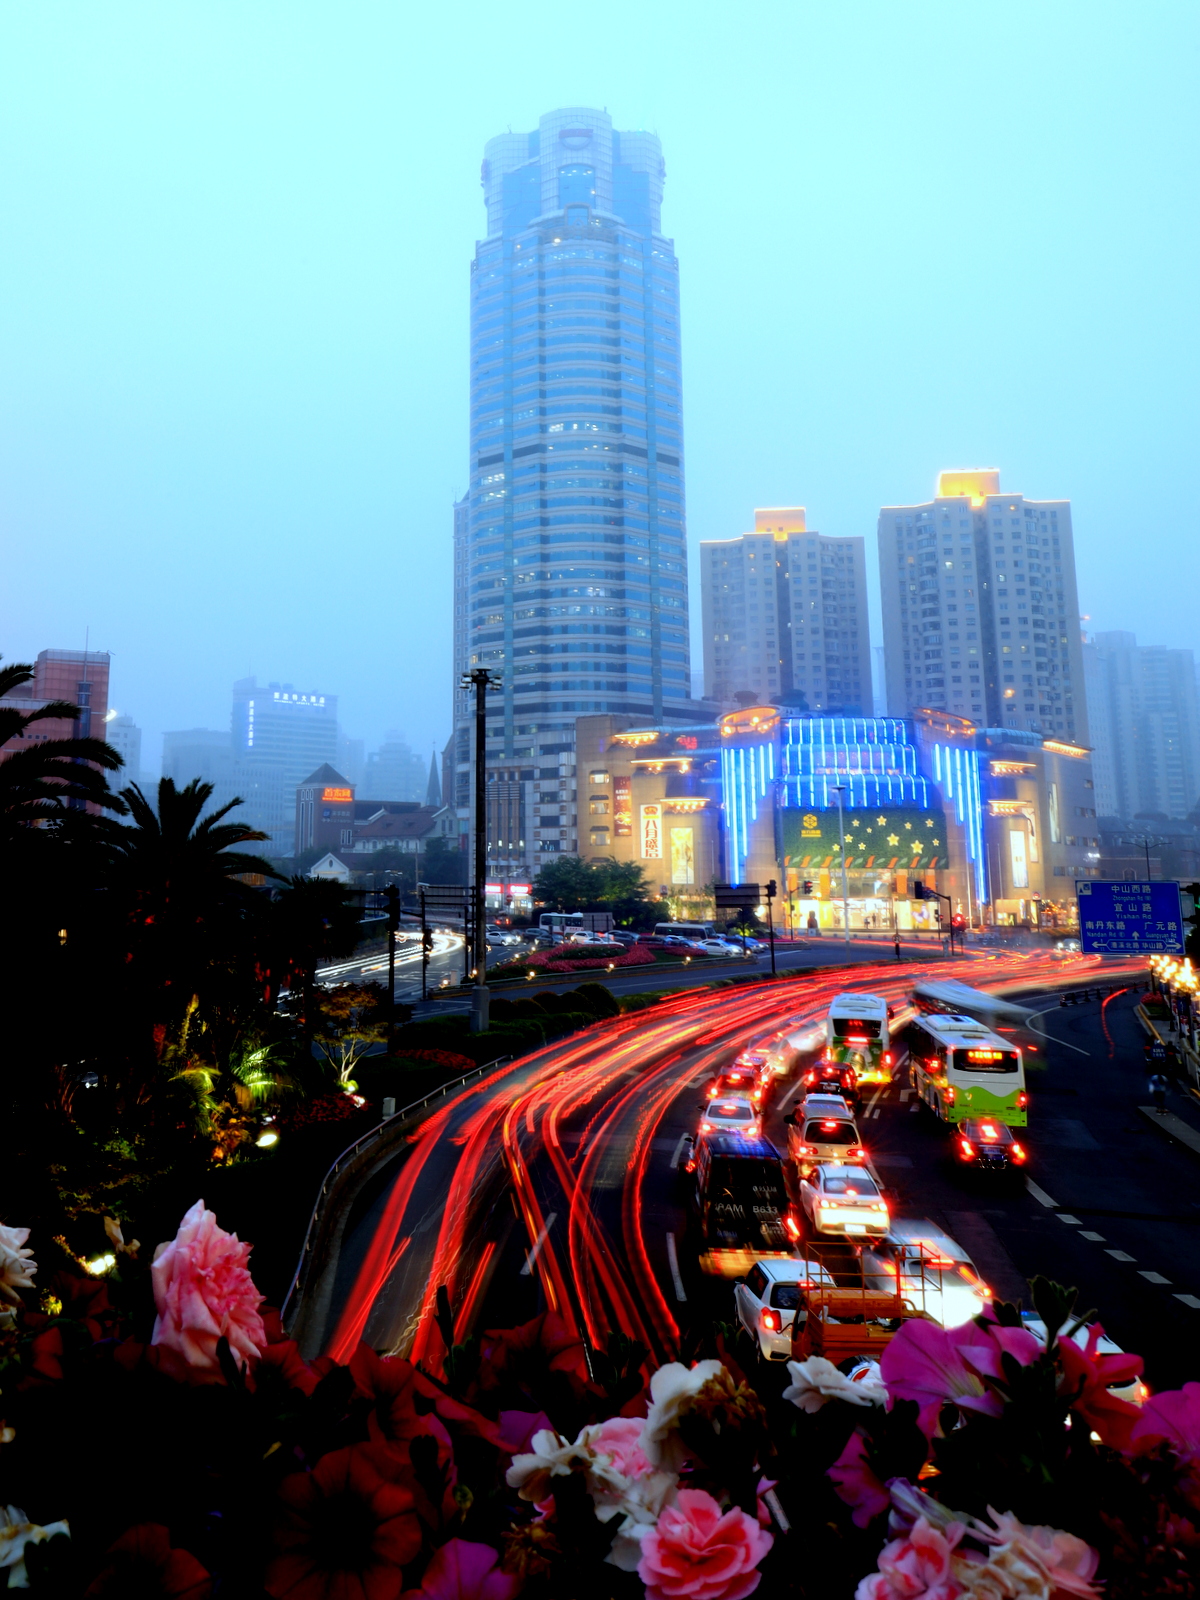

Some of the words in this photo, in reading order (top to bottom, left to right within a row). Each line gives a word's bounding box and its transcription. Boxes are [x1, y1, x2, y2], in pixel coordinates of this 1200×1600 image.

[644, 820, 659, 857] 八月盛启
[1111, 884, 1151, 893] 中山西路
[1114, 903, 1152, 912] 宜山路
[1085, 921, 1126, 930] 南丹东路
[1144, 921, 1177, 931] 广元路
[752, 1205, 778, 1214] B633
